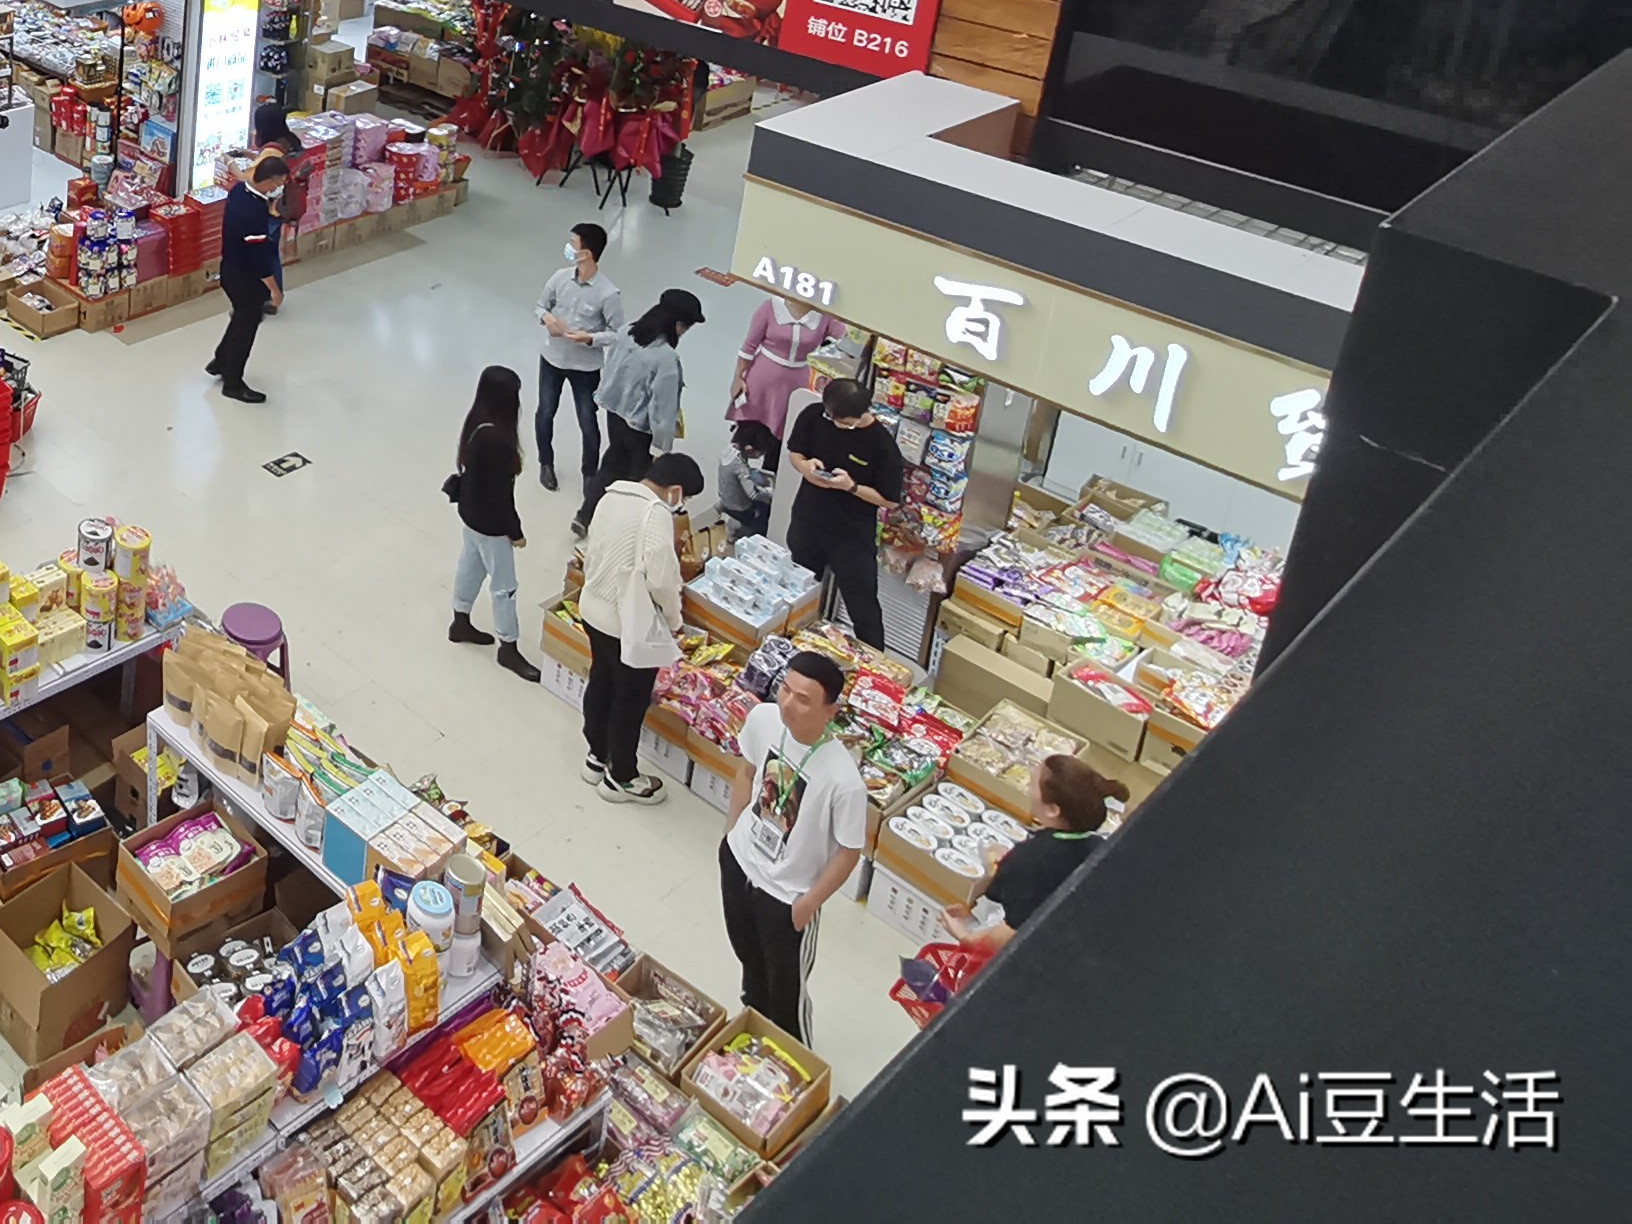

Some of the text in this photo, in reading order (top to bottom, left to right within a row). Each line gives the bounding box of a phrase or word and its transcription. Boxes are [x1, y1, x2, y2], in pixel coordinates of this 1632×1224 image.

[806, 15, 910, 59] 铺位 B216
[752, 256, 836, 307] A181
